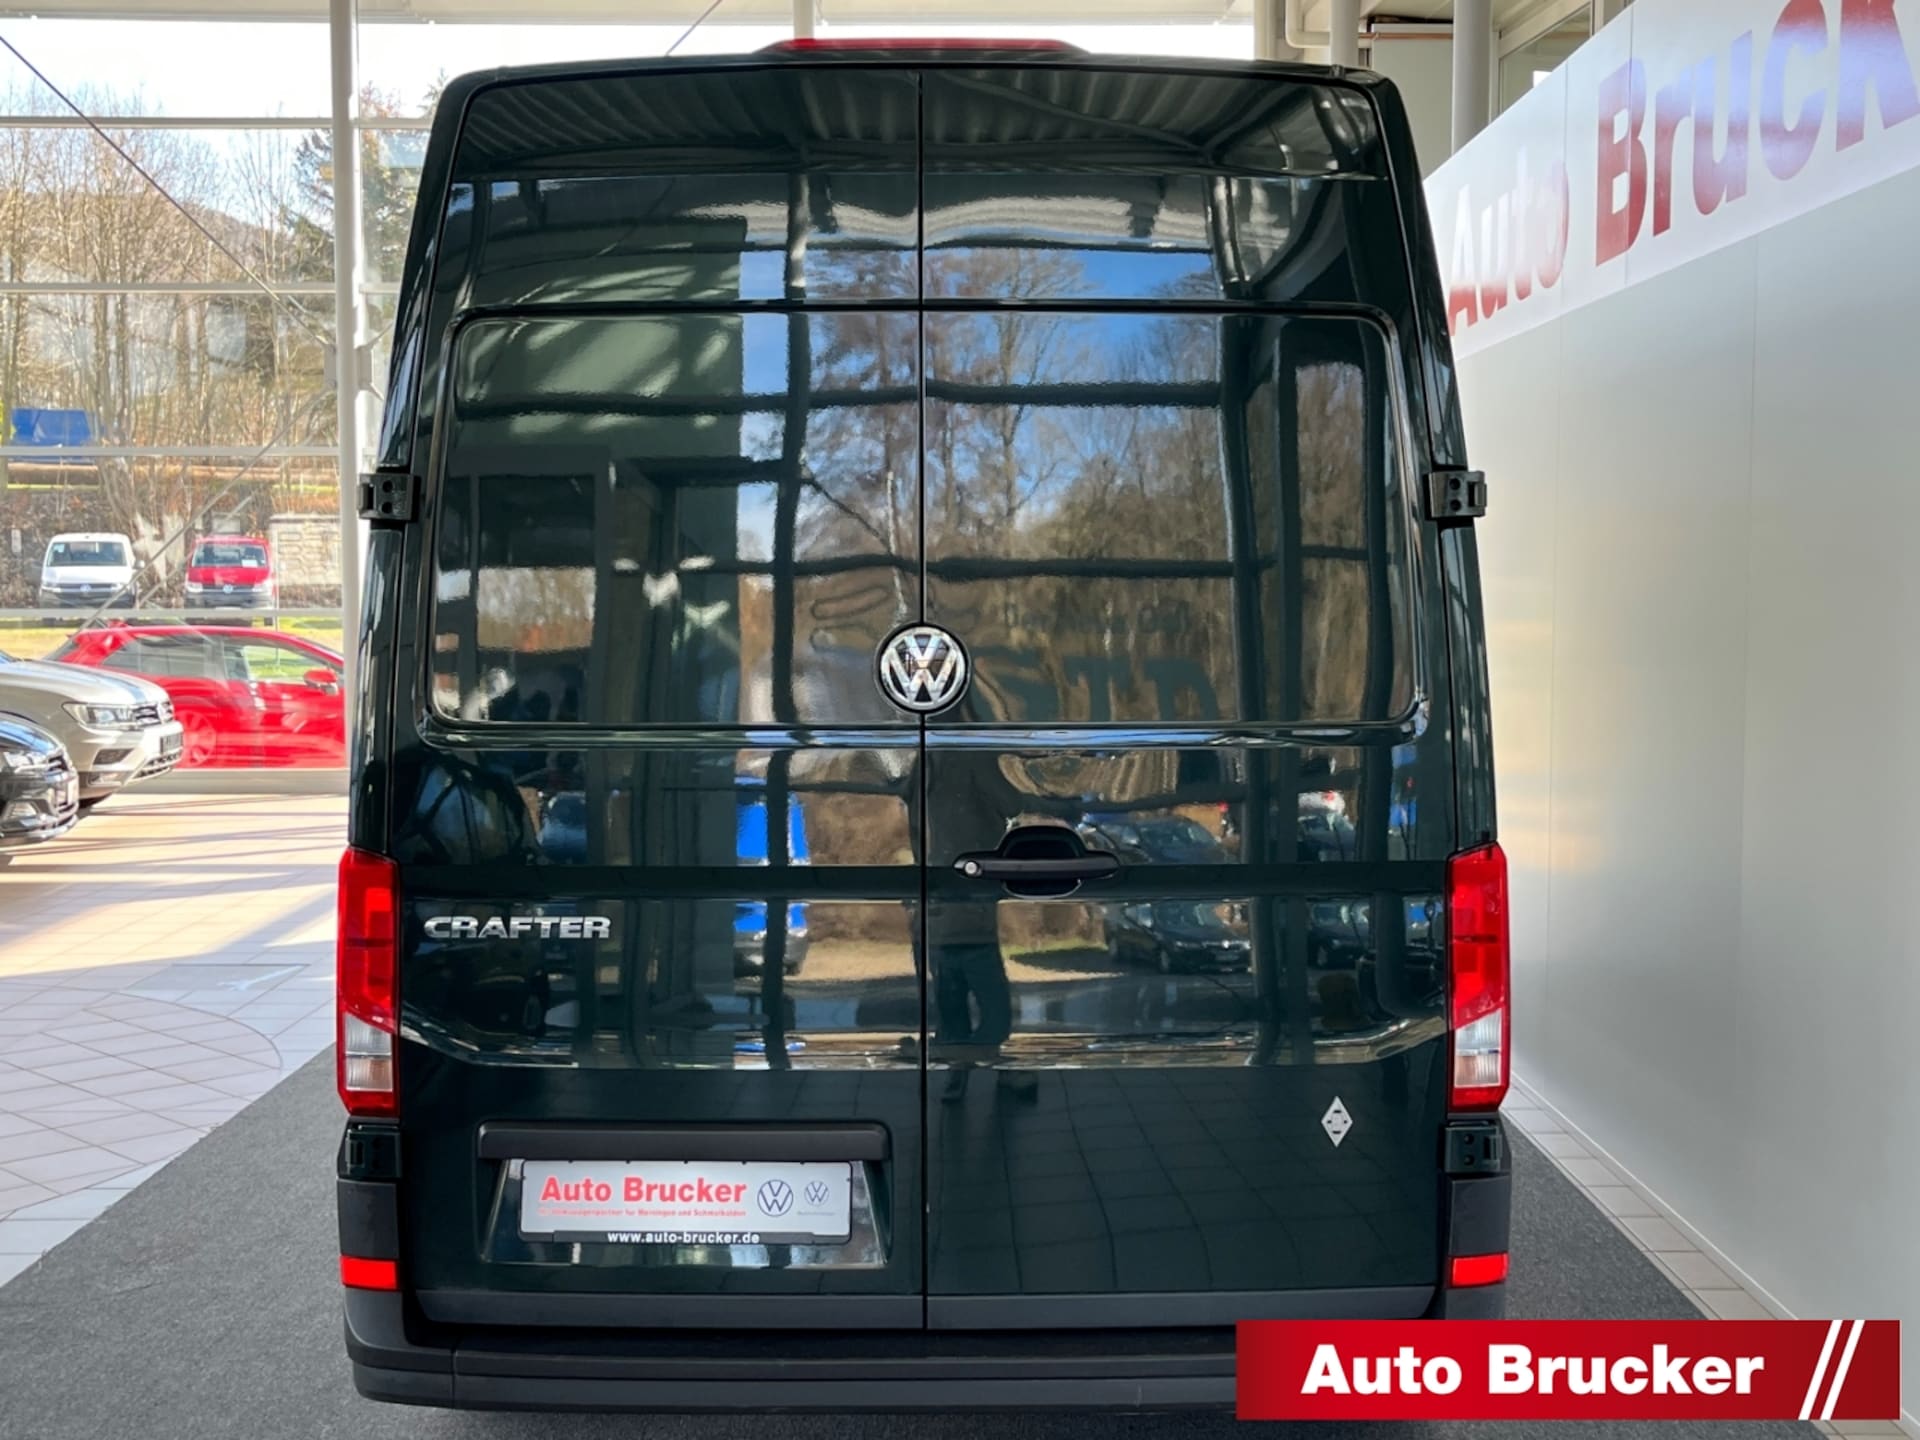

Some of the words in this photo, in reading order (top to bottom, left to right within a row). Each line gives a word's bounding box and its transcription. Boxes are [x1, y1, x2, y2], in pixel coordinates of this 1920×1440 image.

[1448, 145, 1569, 336] Auto
[424, 915, 612, 939] CRAFTER
[541, 1176, 612, 1202] Auto
[623, 1176, 747, 1202] Brucker
[607, 1231, 760, 1244] www.auto-brucker.de
